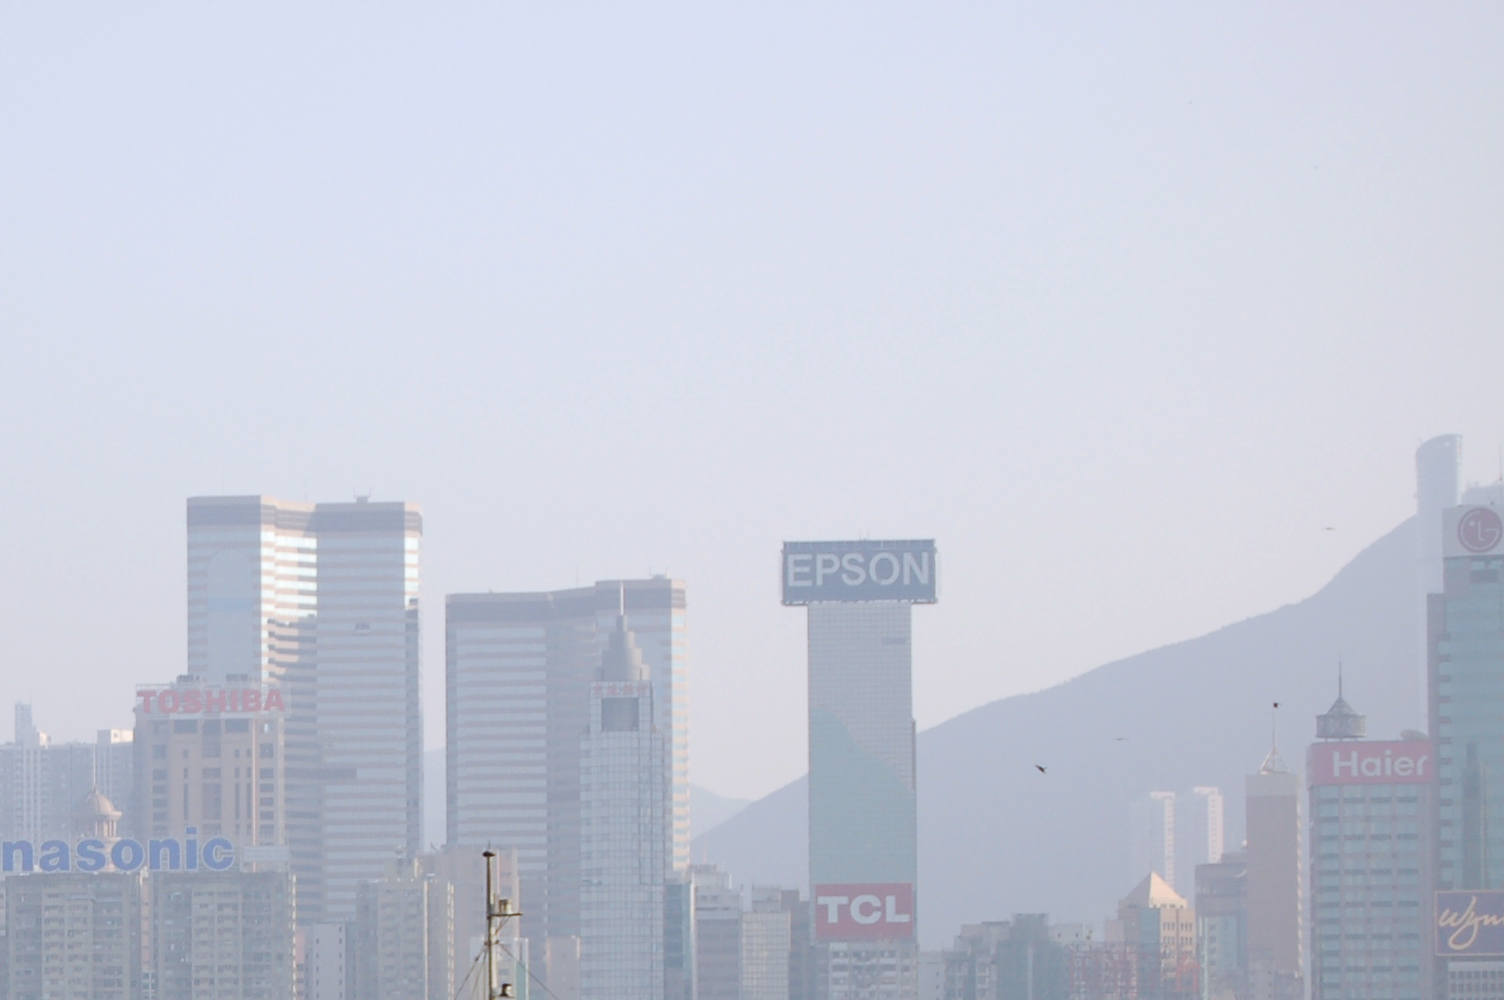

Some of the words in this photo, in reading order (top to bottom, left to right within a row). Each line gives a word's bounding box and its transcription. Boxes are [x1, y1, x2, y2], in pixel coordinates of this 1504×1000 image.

[787, 551, 930, 588] EPSON
[136, 688, 286, 714] TOSHIBA
[1333, 750, 1428, 777] Haier
[816, 894, 911, 925] TCL
